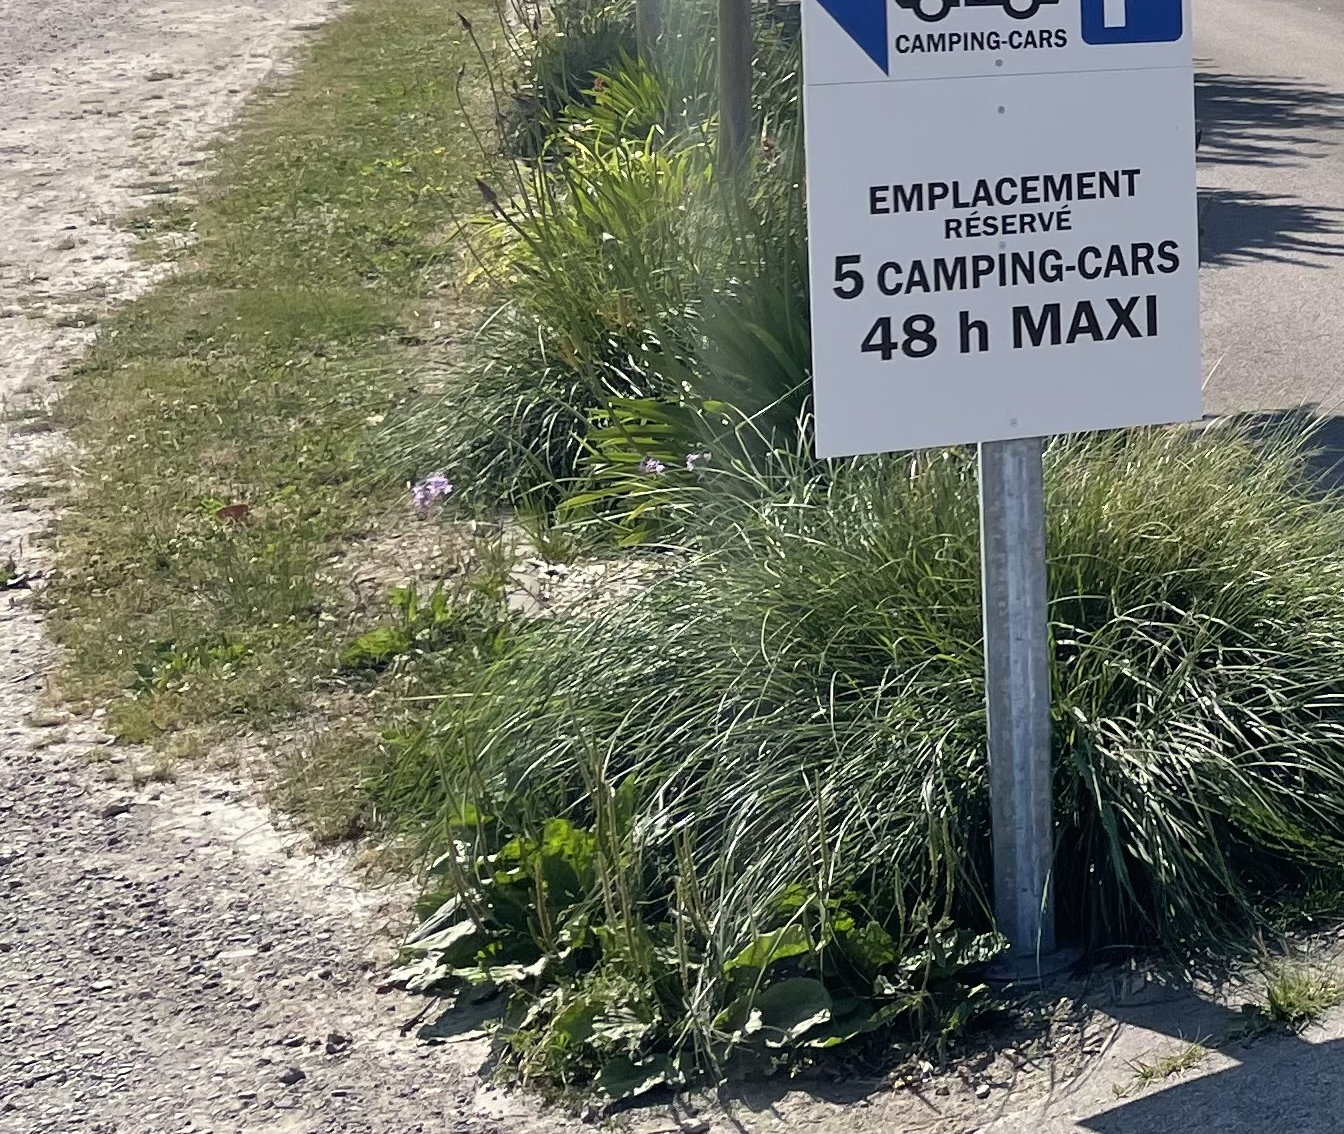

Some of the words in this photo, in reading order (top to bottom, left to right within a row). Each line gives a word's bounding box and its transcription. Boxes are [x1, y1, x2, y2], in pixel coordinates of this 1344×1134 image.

[895, 27, 1068, 54] CAMPING-CARS
[869, 169, 1140, 215] EMPLACEMENT
[944, 204, 1072, 239] RÉSERVÉ
[833, 253, 864, 299] 5
[877, 239, 1180, 296] CAMPING-CARS
[860, 313, 937, 360] 48
[960, 311, 988, 353] h
[1013, 295, 1157, 349] MAXI
